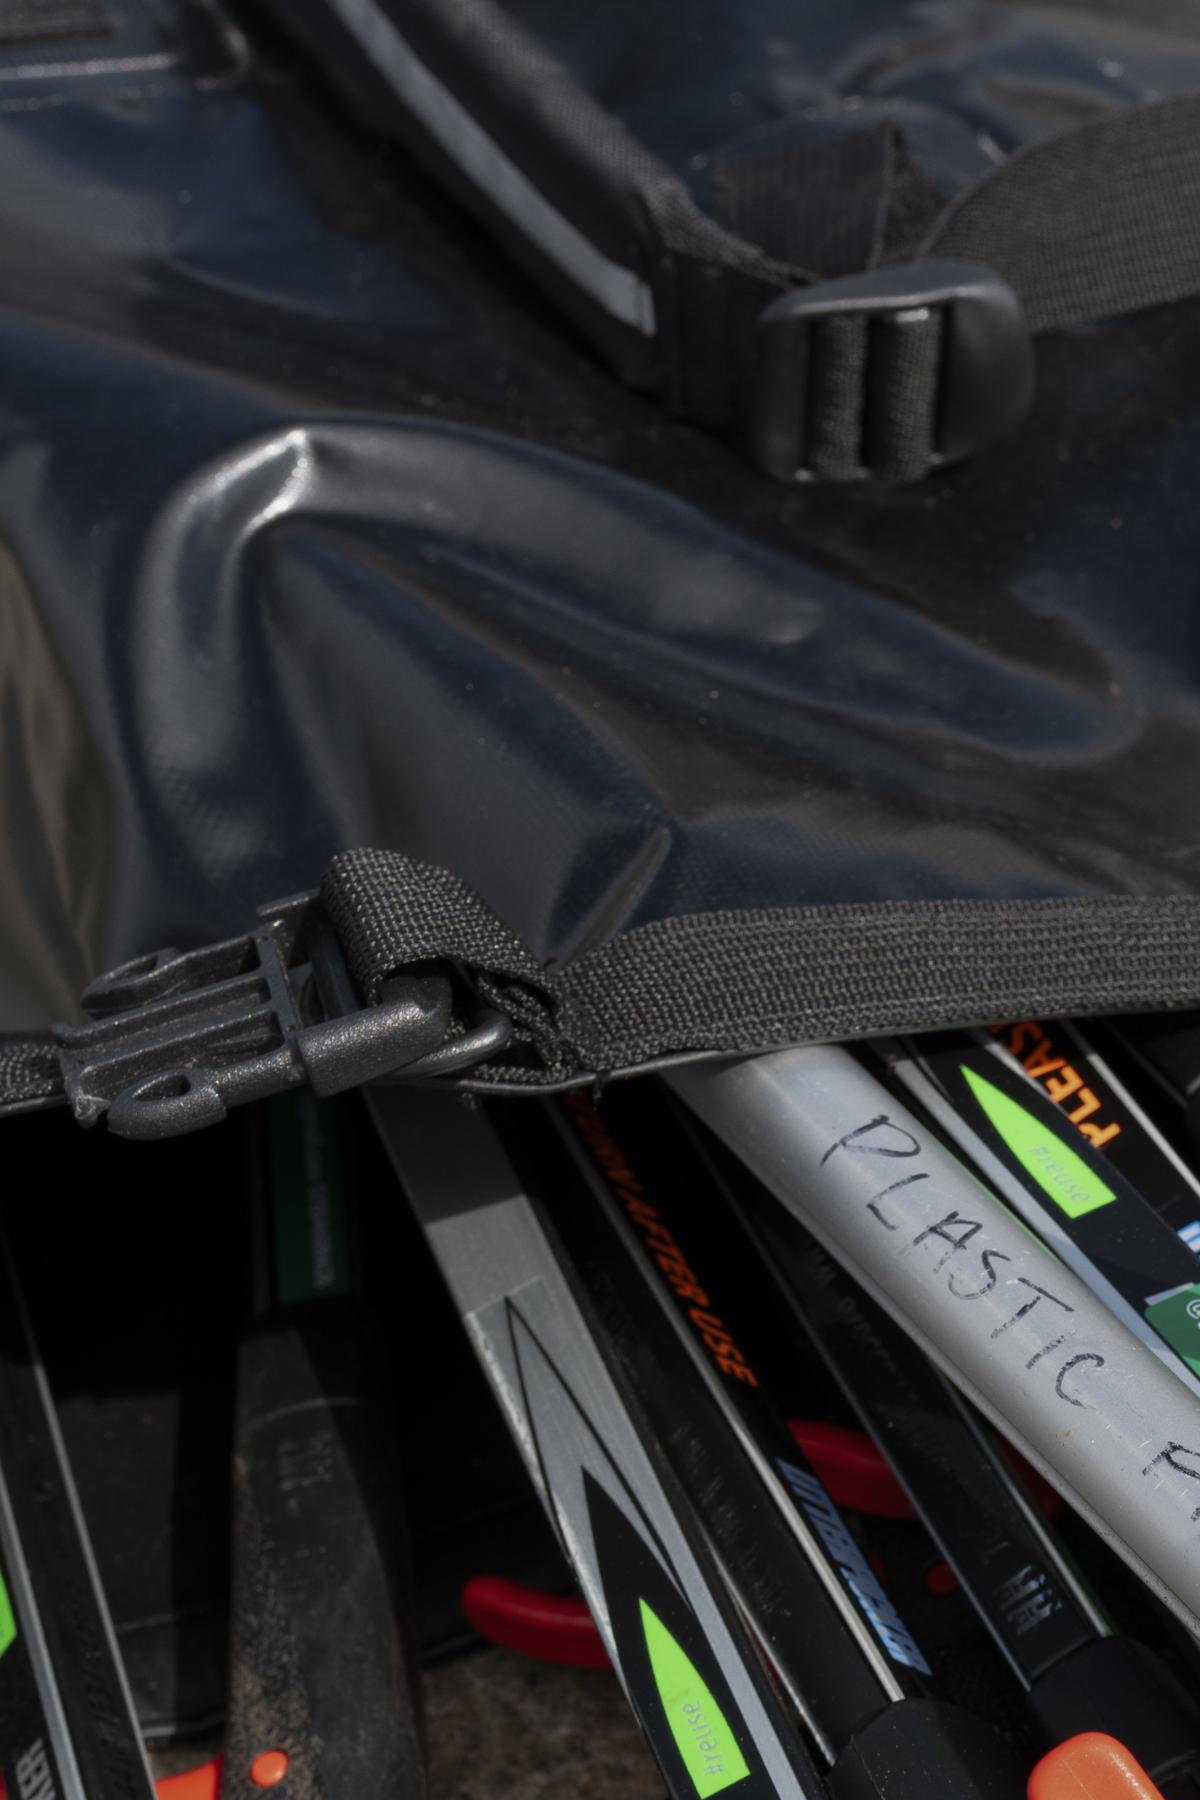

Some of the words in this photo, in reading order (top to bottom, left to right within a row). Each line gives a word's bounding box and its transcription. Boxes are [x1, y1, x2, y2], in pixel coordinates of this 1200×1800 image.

[991, 1022, 1121, 1149] PLEAS
[616, 1185, 709, 1308] AFTER
[687, 1306, 758, 1388] USE
[819, 1114, 1105, 1408] PLASTIC
[680, 1698, 728, 1778] #reuse
